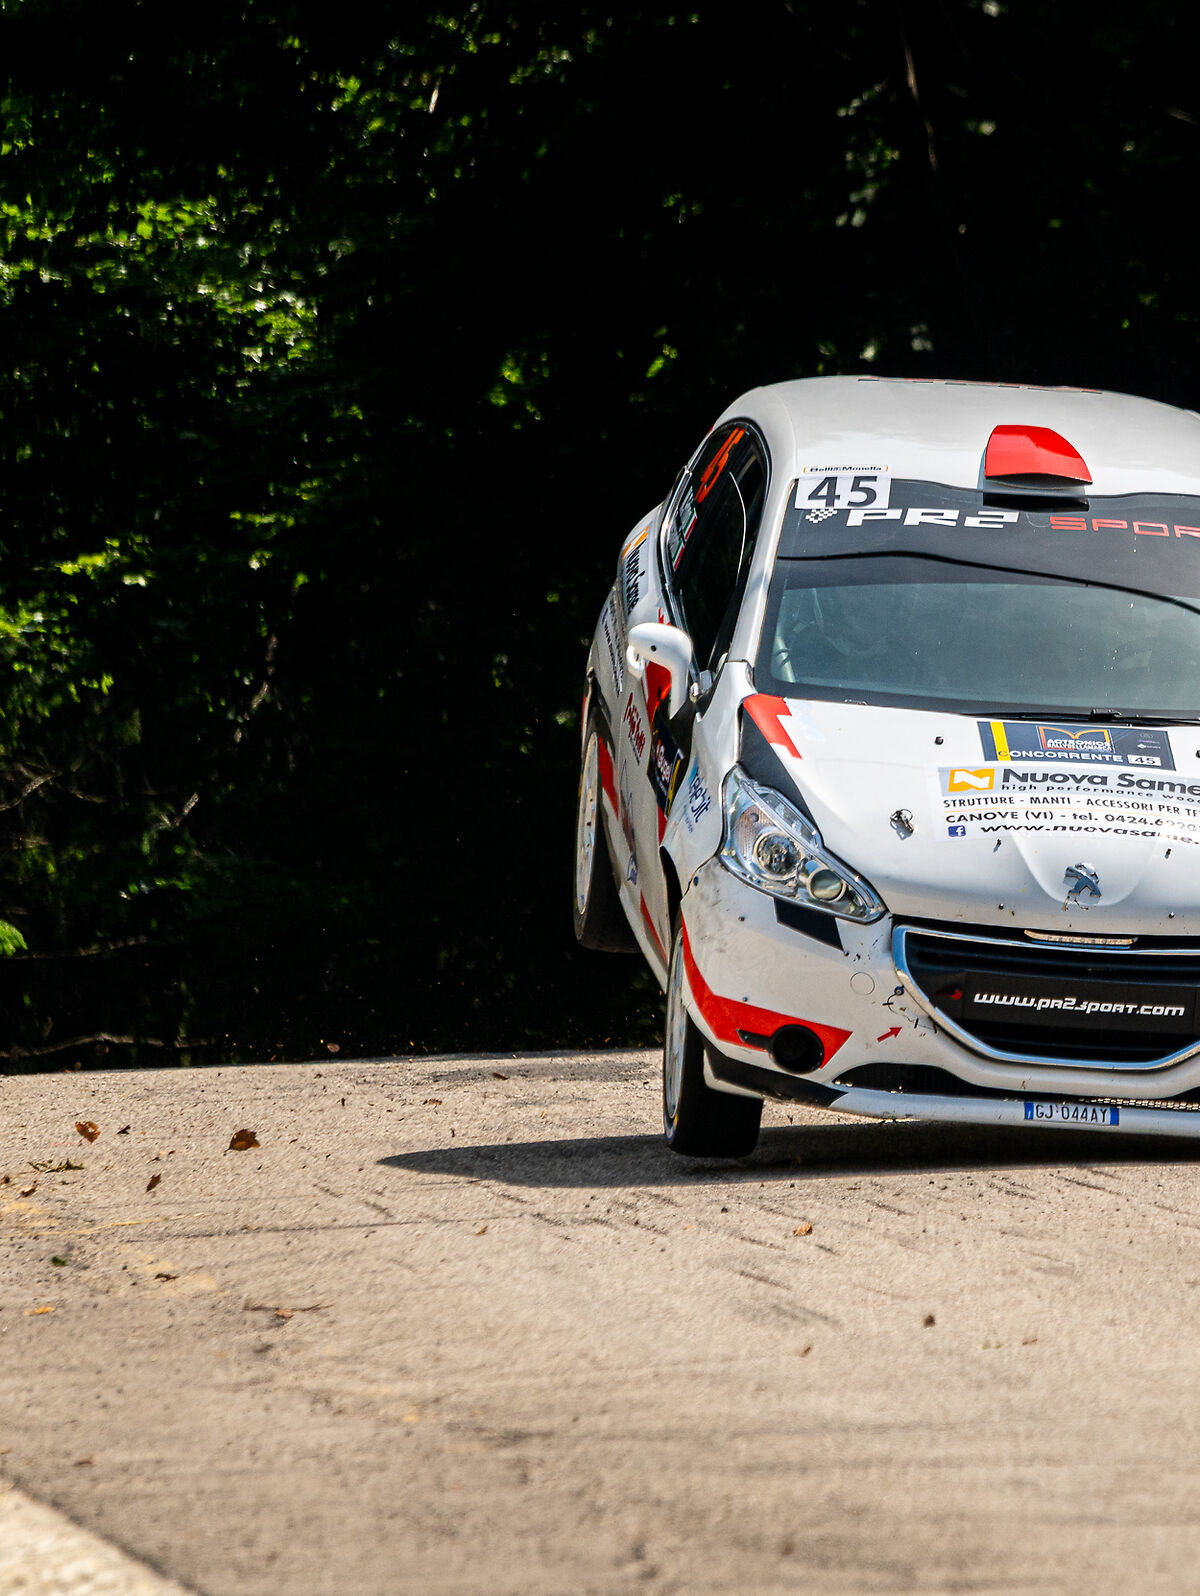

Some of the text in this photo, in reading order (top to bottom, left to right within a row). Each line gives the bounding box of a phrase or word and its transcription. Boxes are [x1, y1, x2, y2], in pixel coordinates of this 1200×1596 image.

[808, 476, 877, 508] 45
[846, 508, 1019, 529] PR2
[998, 750, 1156, 765] CONCORRENTE 45
[1001, 784, 1037, 792] high
[1046, 785, 1153, 798] performance
[943, 796, 1015, 808] STRUTTURE
[1030, 796, 1071, 805] MANTI
[1086, 798, 1153, 811] ACCESSORI
[1158, 804, 1180, 815] PER
[945, 811, 1019, 824] CANOVE
[1025, 810, 1054, 821] (VI)
[1072, 812, 1098, 821] tel.
[973, 992, 1186, 1017] www.pr2sport.com
[1035, 1104, 1107, 1123] GJ 044AY
